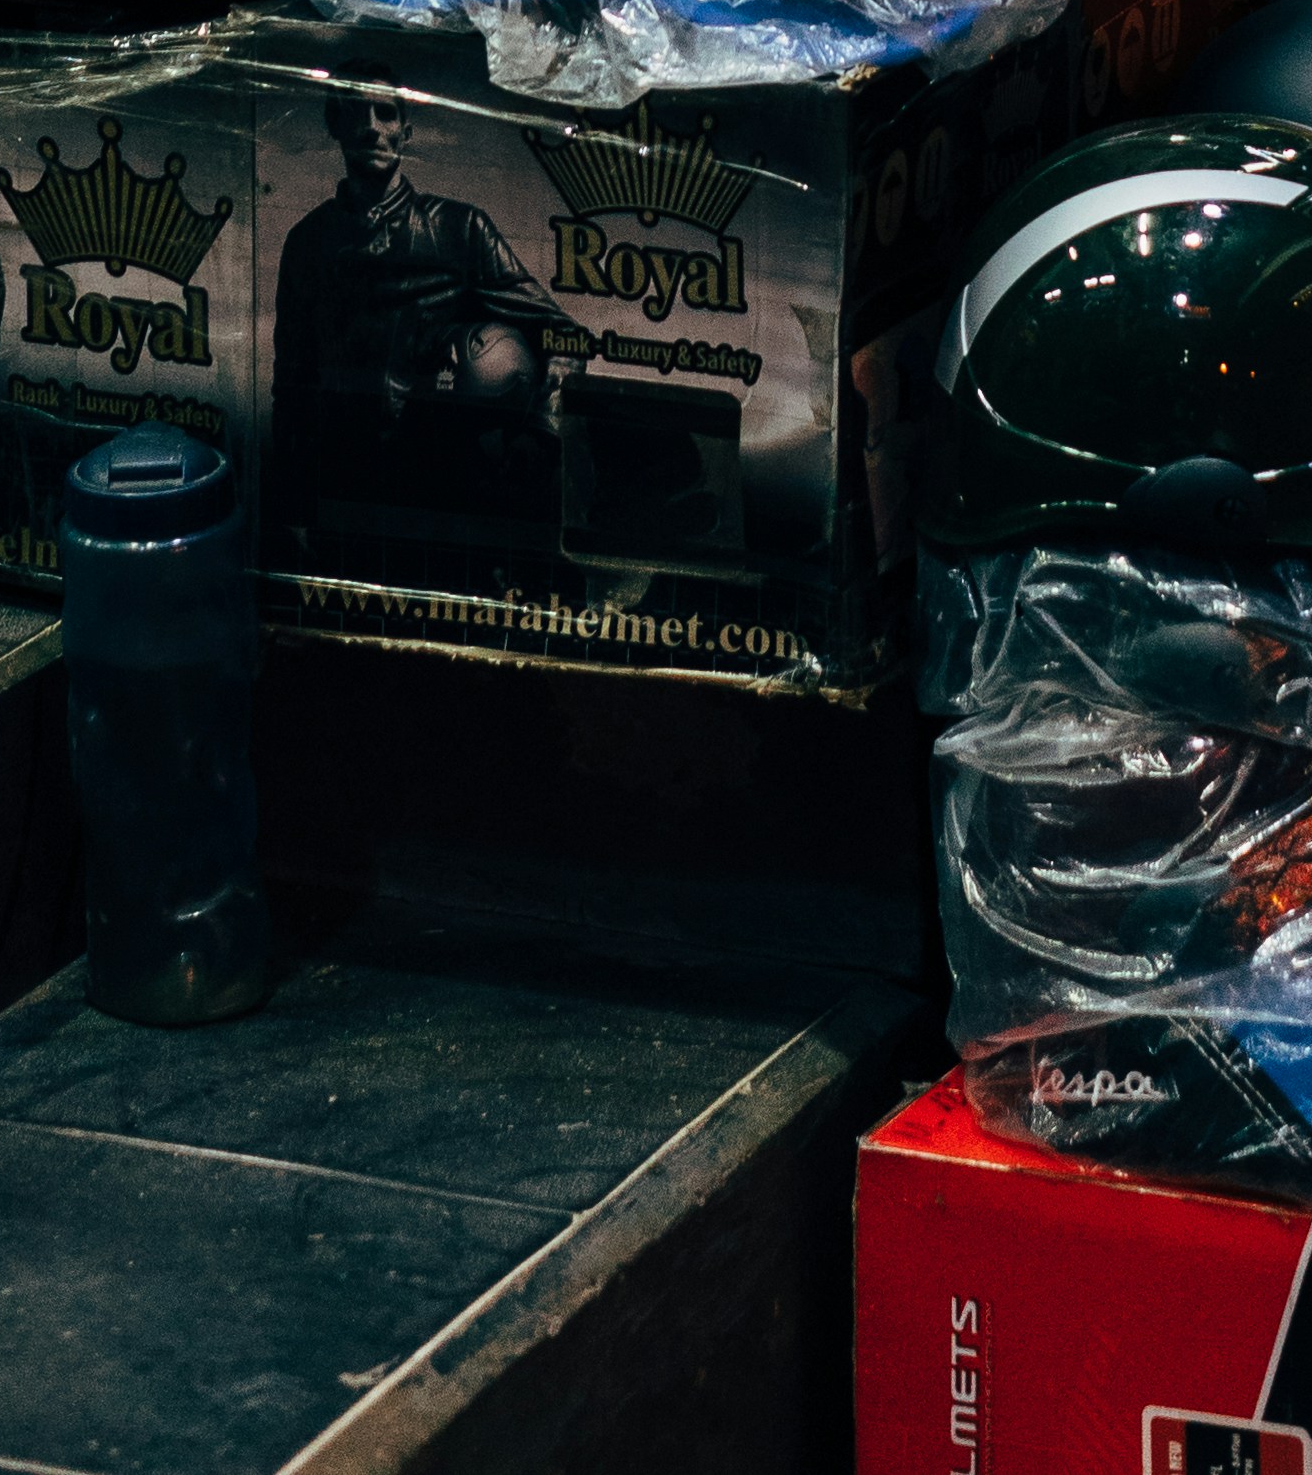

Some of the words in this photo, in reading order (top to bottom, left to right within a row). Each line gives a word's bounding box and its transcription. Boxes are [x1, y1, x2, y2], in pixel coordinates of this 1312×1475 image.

[552, 214, 747, 321] Royal
[20, 264, 212, 374] Royal
[539, 327, 594, 355] Rank
[603, 333, 674, 371] Luxury
[676, 343, 693, 365] &
[693, 343, 760, 383] Safety
[79, 385, 142, 426] Luxury
[161, 396, 223, 437] Safety
